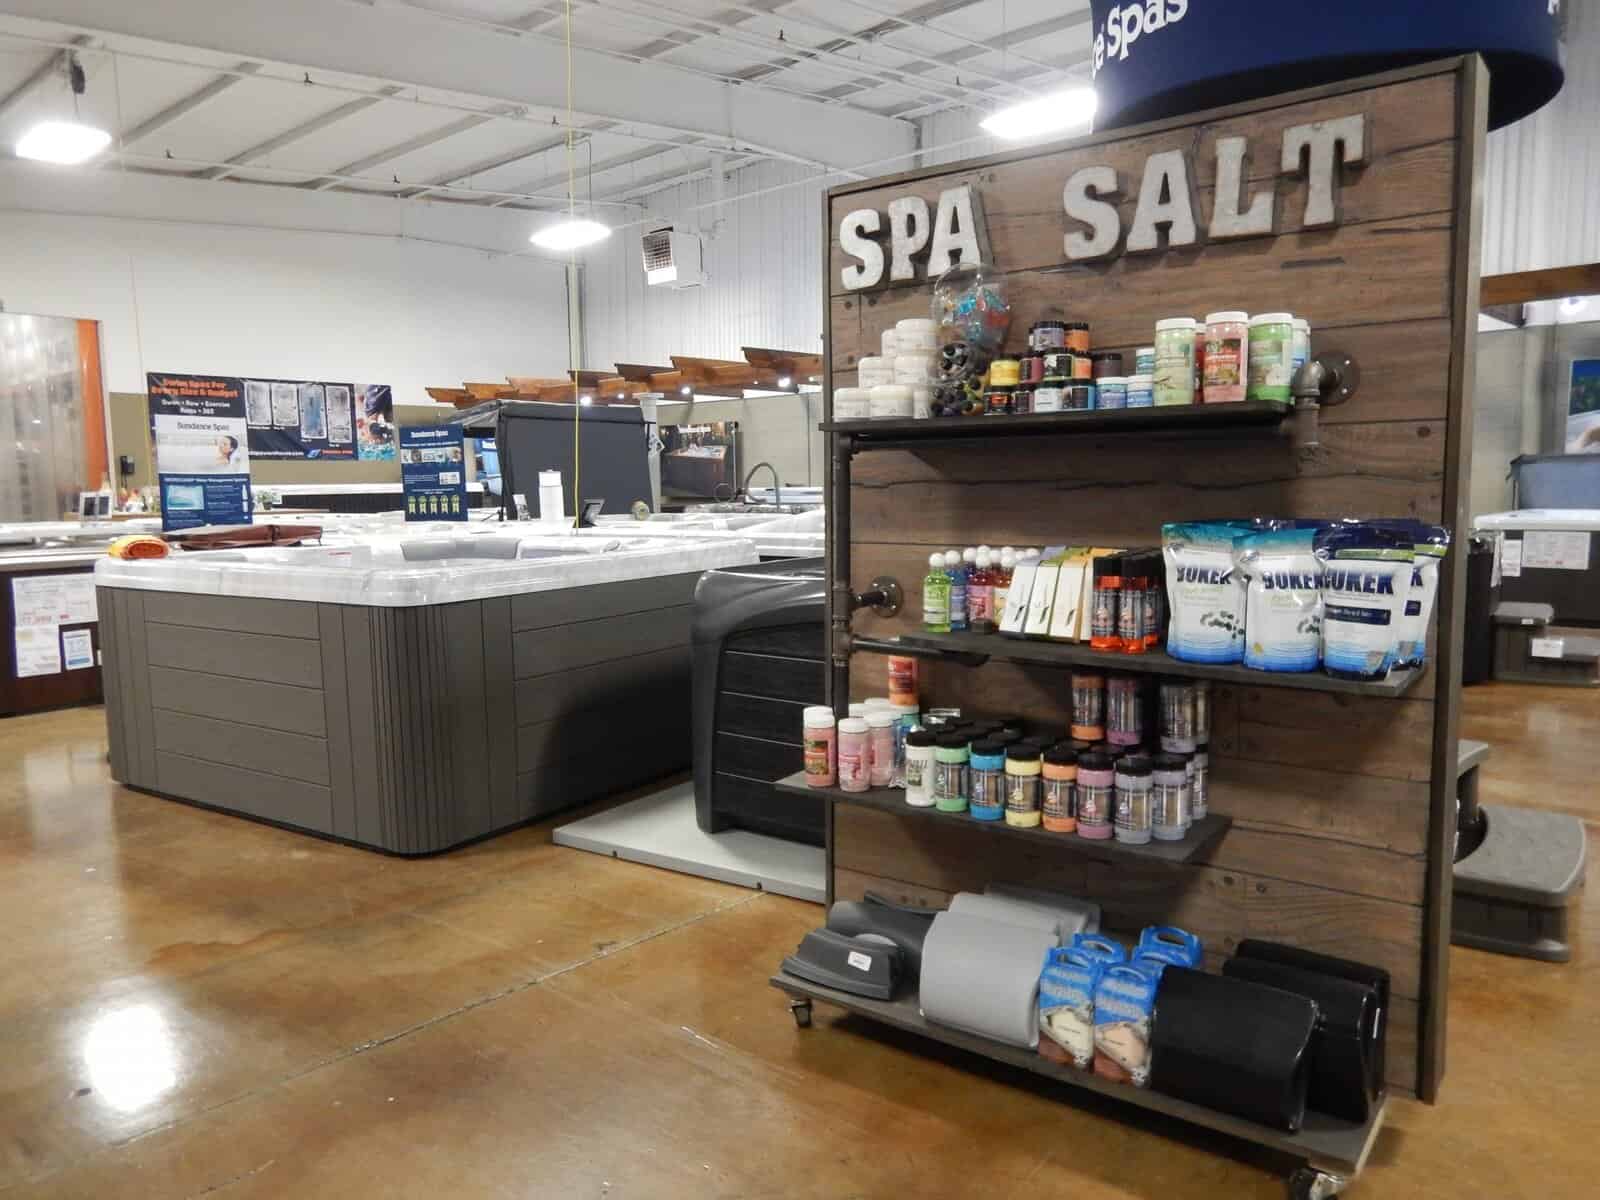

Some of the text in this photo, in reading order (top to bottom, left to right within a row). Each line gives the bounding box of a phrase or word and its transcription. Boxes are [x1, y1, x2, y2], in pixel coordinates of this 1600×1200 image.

[839, 112, 1366, 291] SPA SALT
[177, 421, 212, 431] Sundance
